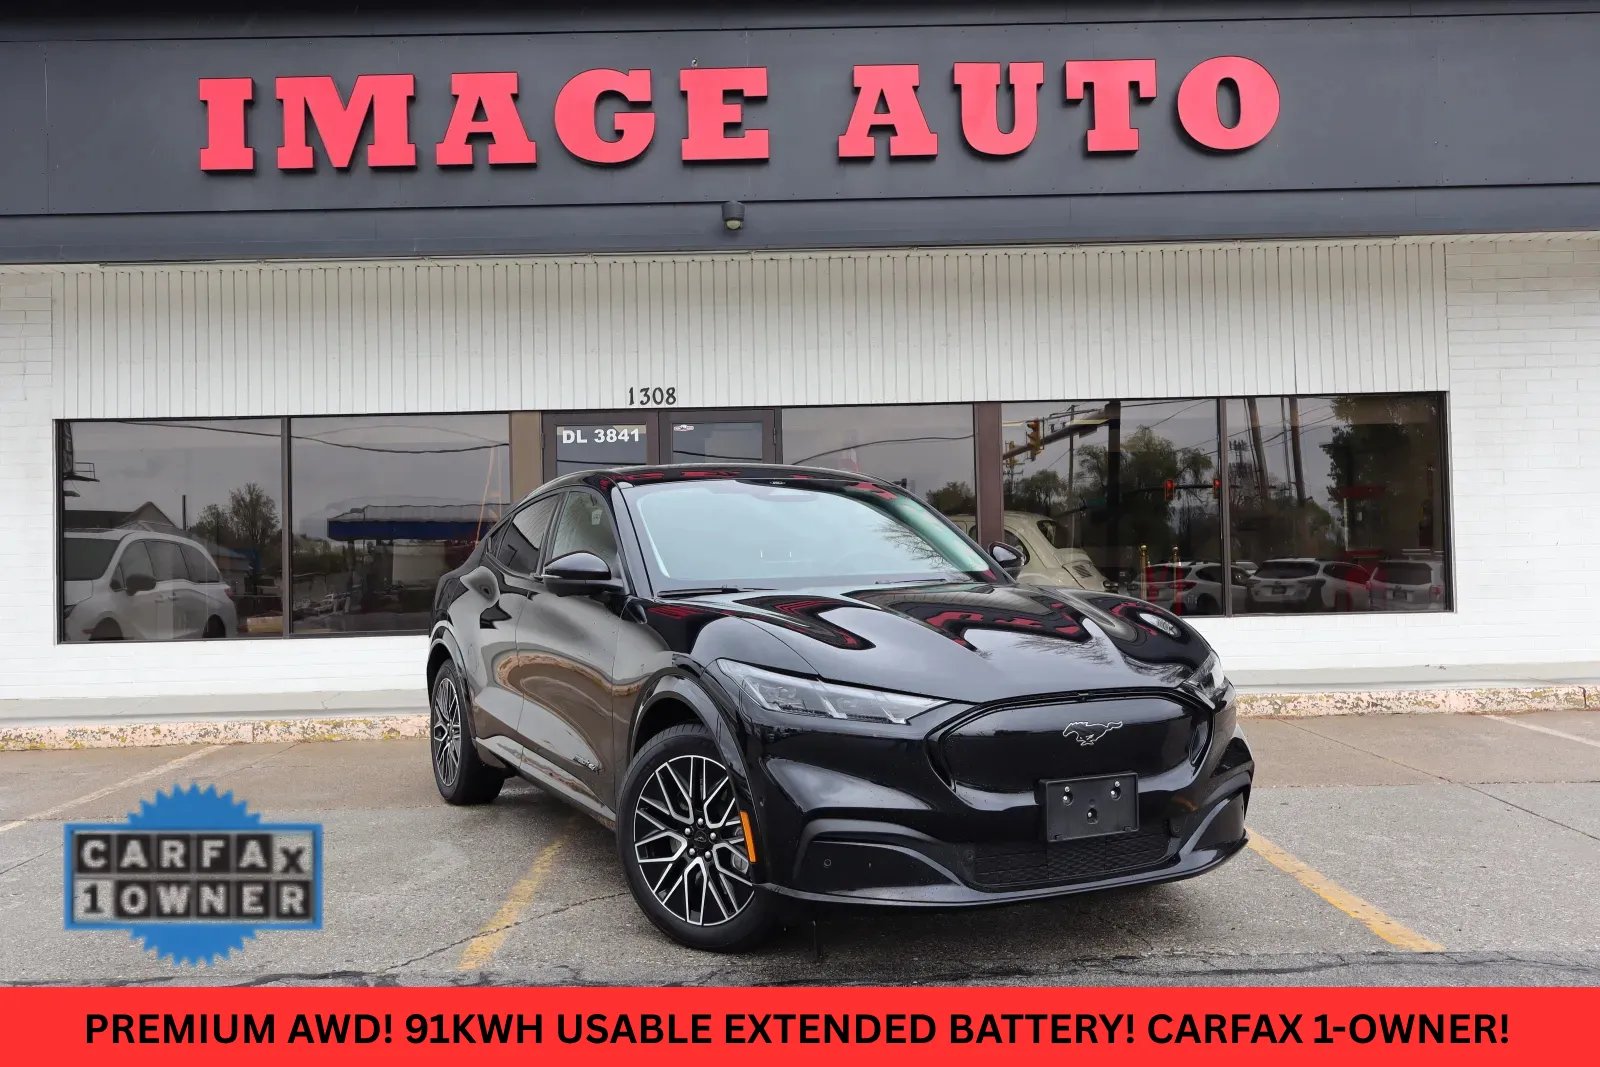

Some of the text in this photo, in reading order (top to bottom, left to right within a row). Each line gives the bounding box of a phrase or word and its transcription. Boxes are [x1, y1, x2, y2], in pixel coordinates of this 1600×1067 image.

[198, 55, 1281, 172] IMAGE AUTO
[628, 386, 677, 406] 1308
[562, 427, 640, 444] DL 3841
